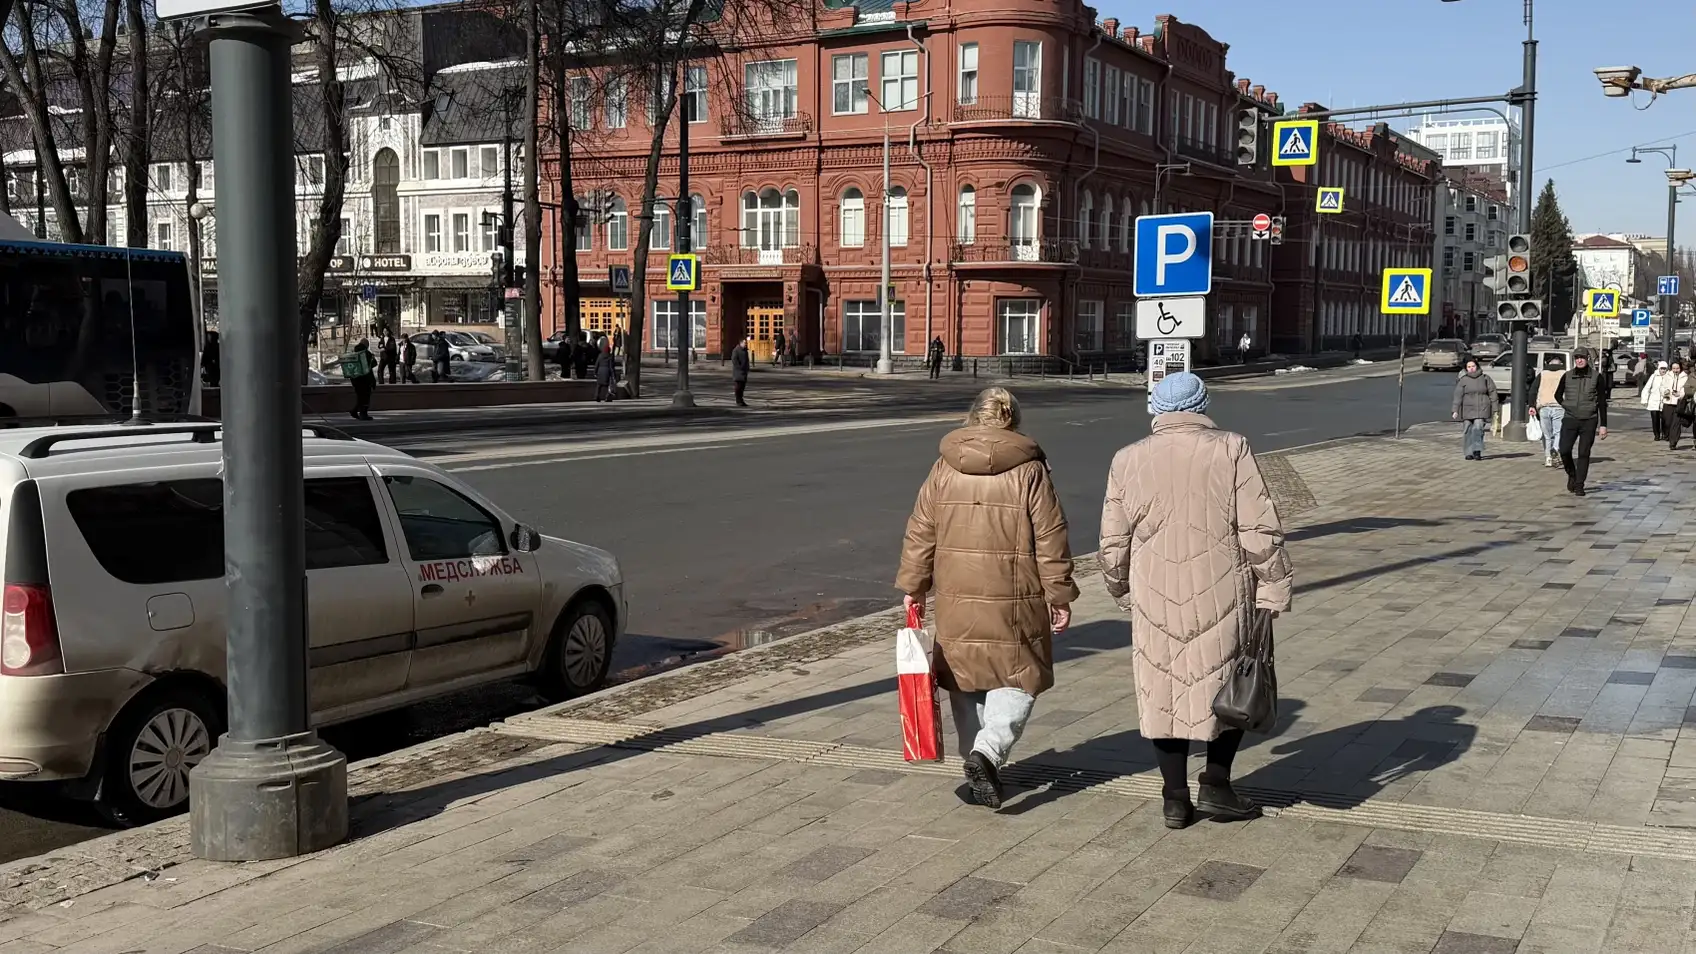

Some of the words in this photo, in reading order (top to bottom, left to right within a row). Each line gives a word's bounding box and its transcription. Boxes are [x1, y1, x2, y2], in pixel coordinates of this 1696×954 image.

[1156, 225, 1197, 286] P
[374, 258, 406, 267] HOTEL
[1636, 310, 1647, 324] P
[1171, 353, 1184, 361] 102
